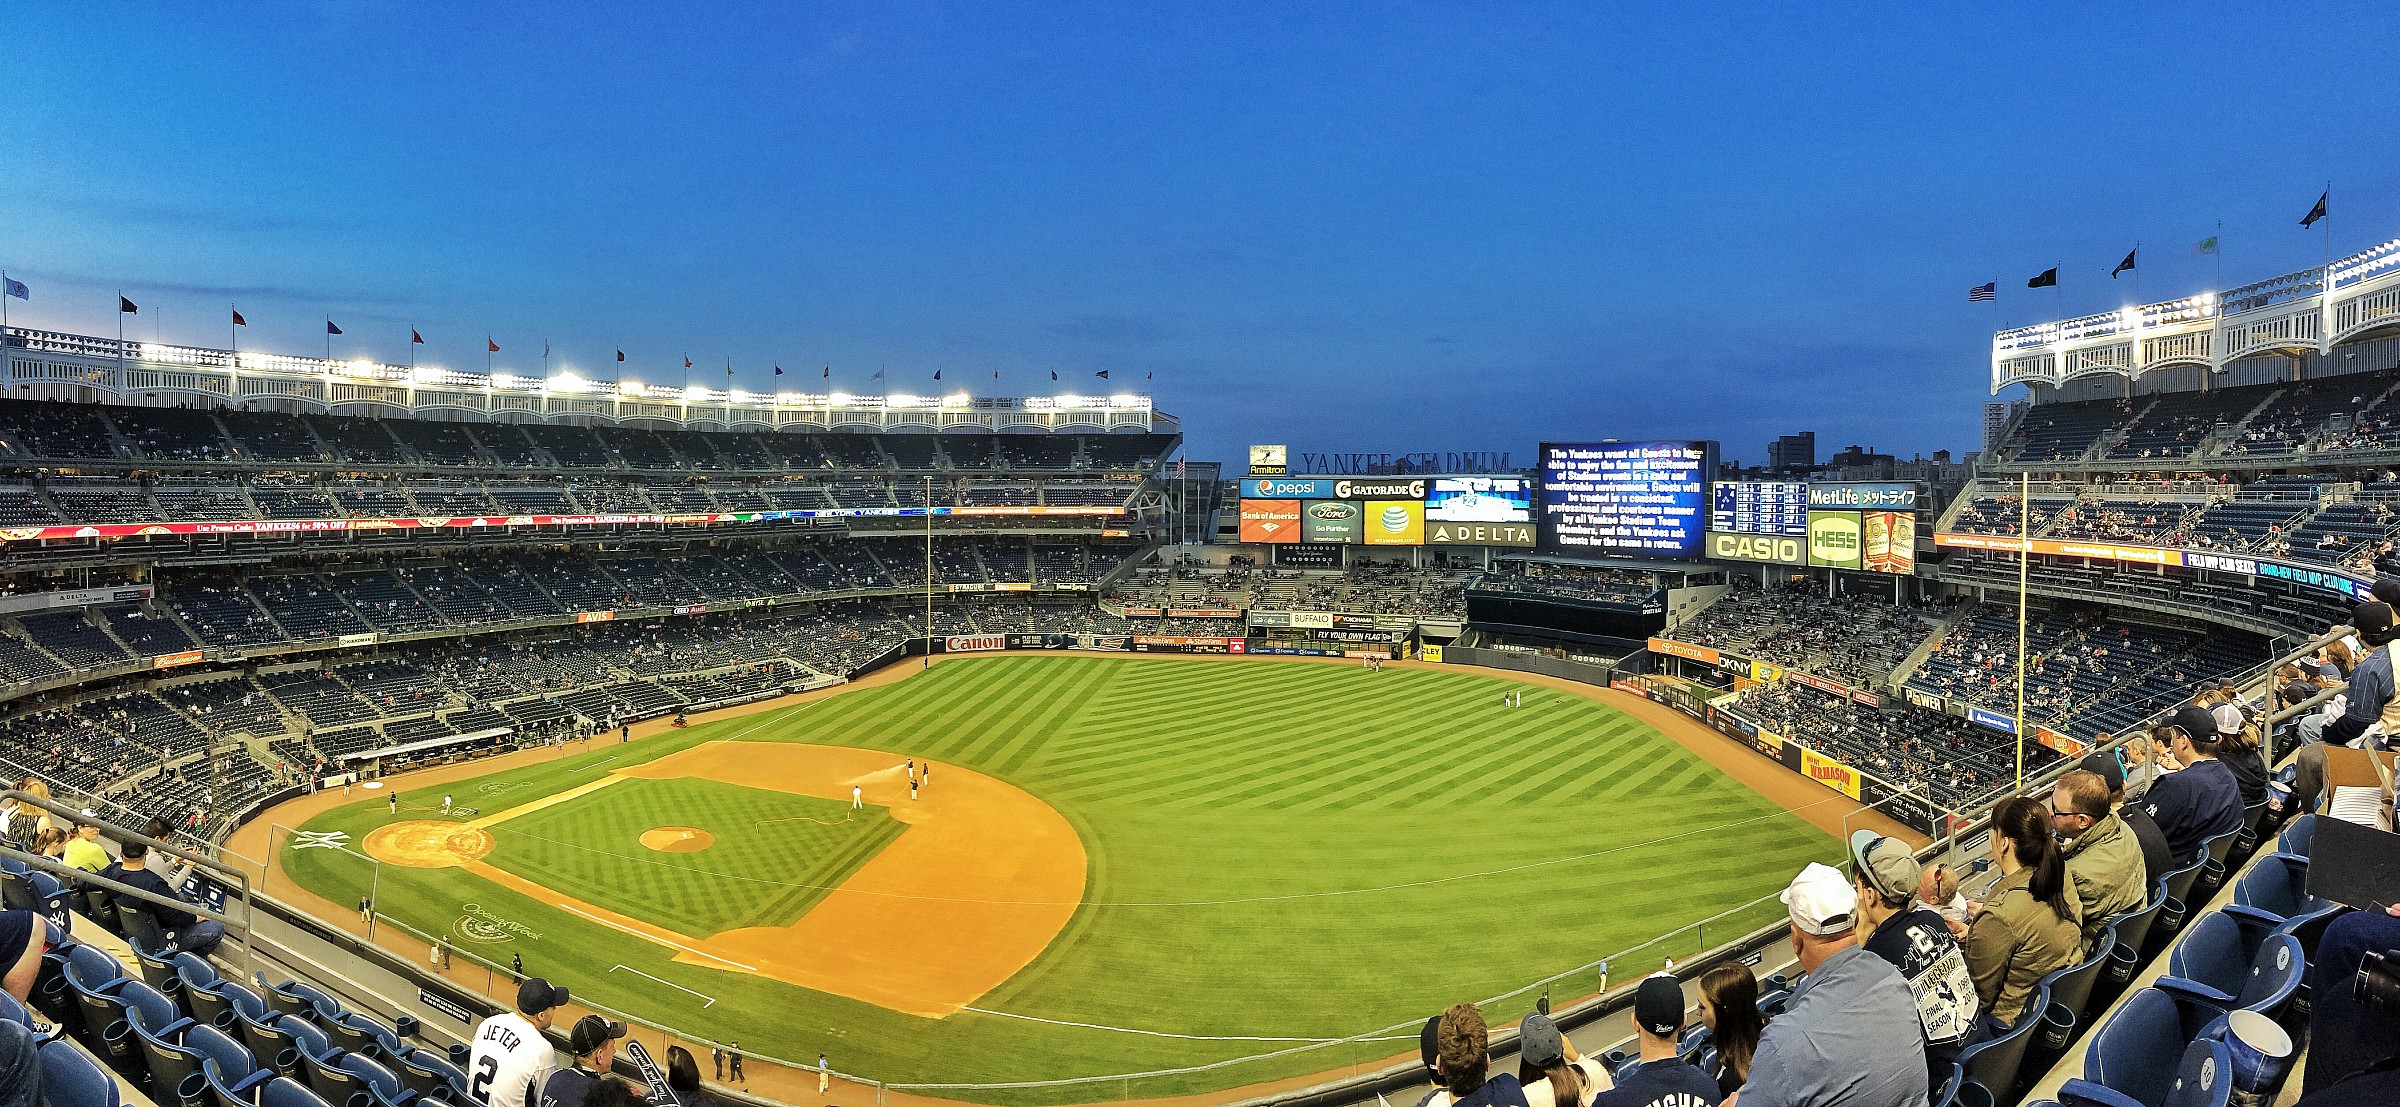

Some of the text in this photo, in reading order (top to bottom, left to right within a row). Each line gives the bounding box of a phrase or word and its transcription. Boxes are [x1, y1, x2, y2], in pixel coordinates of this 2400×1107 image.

[1550, 449, 1567, 458] The
[1569, 449, 1603, 459] Yankees
[1629, 449, 1639, 458] all
[1642, 448, 1671, 458] Guests
[1672, 448, 1681, 458] to
[1250, 466, 1286, 474] Armitron
[1302, 452, 1510, 475] YANKEE STADIUM
[1567, 461, 1576, 469] to
[1557, 471, 1566, 480] of
[1568, 470, 1601, 480] Stadium
[1277, 482, 1315, 495] pepsi
[1353, 484, 1408, 496] GATORADE
[1545, 481, 1594, 491] comfortable
[1652, 481, 1681, 492] Guests
[1682, 482, 1700, 492] will
[1810, 488, 1859, 505] MetLife
[1863, 491, 1915, 505] メットライフ
[1318, 505, 1347, 518] Ford
[1548, 503, 1599, 514] professional
[1269, 512, 1299, 520] America
[1563, 513, 1574, 525] by
[1575, 514, 1586, 523] all
[1587, 514, 1618, 524] Yankee
[1620, 515, 1655, 525] Stadium
[1458, 526, 1530, 542] DELTA
[1633, 526, 1669, 537] Yankees
[1815, 531, 1856, 549] HESS
[1716, 535, 1798, 562] CASIO
[2235, 559, 2256, 574] SEATS
[2259, 563, 2291, 579] BRAND-NEW
[2292, 569, 2307, 582] FIELD
[2308, 571, 2322, 585] MVP
[585, 612, 607, 622] AVIS
[1295, 615, 1329, 623] BUFFALO
[1342, 616, 1373, 624] YOKOHAMA
[346, 637, 372, 645] KIKKOMAN
[947, 636, 1004, 650] Canon
[1318, 631, 1329, 639] FLY
[1348, 632, 1363, 640] OWN
[1364, 633, 1381, 641] FLAG
[1674, 645, 1702, 658] TOYOTA
[154, 653, 203, 668] Budweiser
[1719, 656, 1751, 674] DKNY
[1760, 667, 1772, 679] SAP
[1871, 786, 1927, 818] SPIDER-MAN
[463, 903, 543, 940] Opening Week
[1906, 925, 1935, 955] 2
[1916, 957, 1931, 970] New
[1923, 957, 1957, 990] LEGEND
[1925, 1002, 1943, 1019] FINAL
[1927, 1012, 1951, 1034] SEASON
[484, 1025, 521, 1053] JETER
[472, 1054, 498, 1104] 2
[630, 1047, 668, 1101] New York Yankees
[2203, 1066, 2212, 1083] 10
